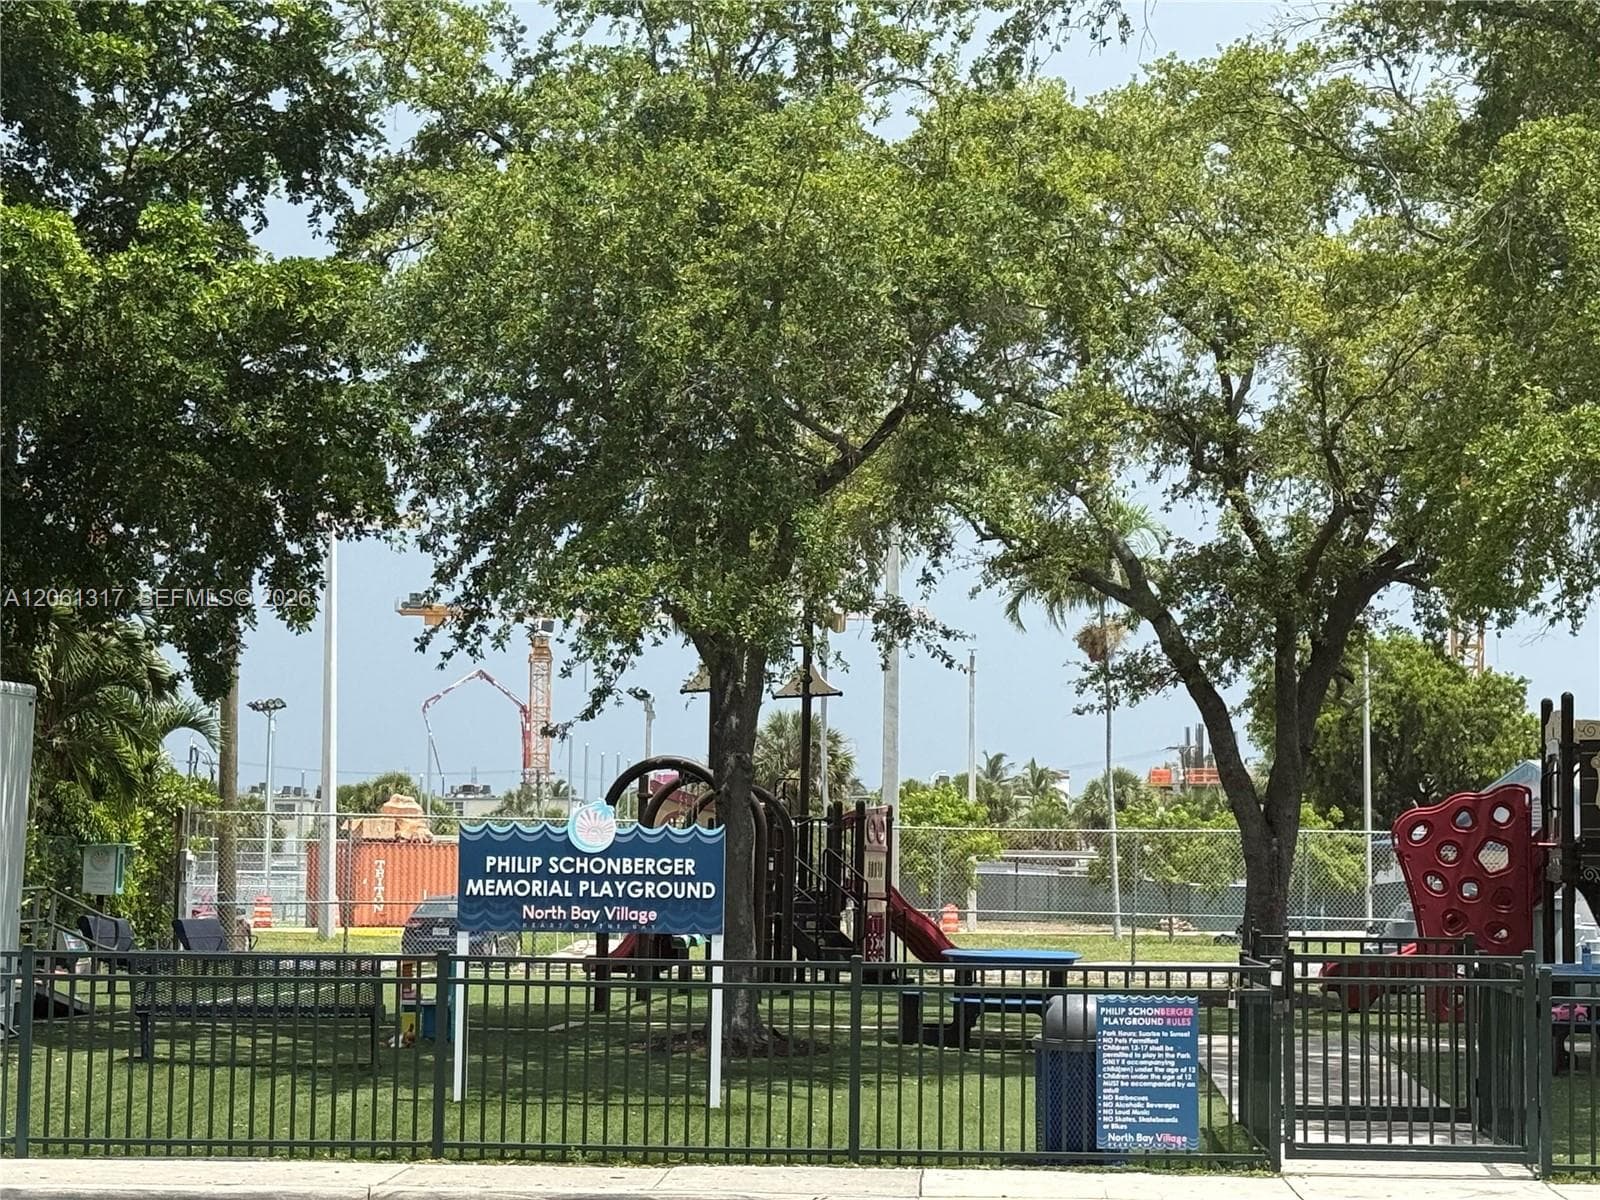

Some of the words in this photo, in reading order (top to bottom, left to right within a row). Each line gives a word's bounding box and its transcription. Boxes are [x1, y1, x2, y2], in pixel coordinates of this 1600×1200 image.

[485, 856, 542, 873] PHILIP
[548, 857, 696, 876] SCHONBERGER
[465, 879, 572, 898] MEMORIAL
[578, 880, 716, 899] PLAYGROUND
[522, 905, 567, 920] North
[571, 905, 600, 924] Bay
[604, 905, 657, 924] Village
[1100, 1007, 1126, 1016] PHILIP
[1128, 1007, 1194, 1017] SCHONBERGER
[1103, 1017, 1164, 1026] PLAYGROUND
[1166, 1017, 1191, 1027] RULES
[1108, 1133, 1134, 1142] North
[1136, 1133, 1154, 1144] Bay
[1156, 1133, 1188, 1144] Village
